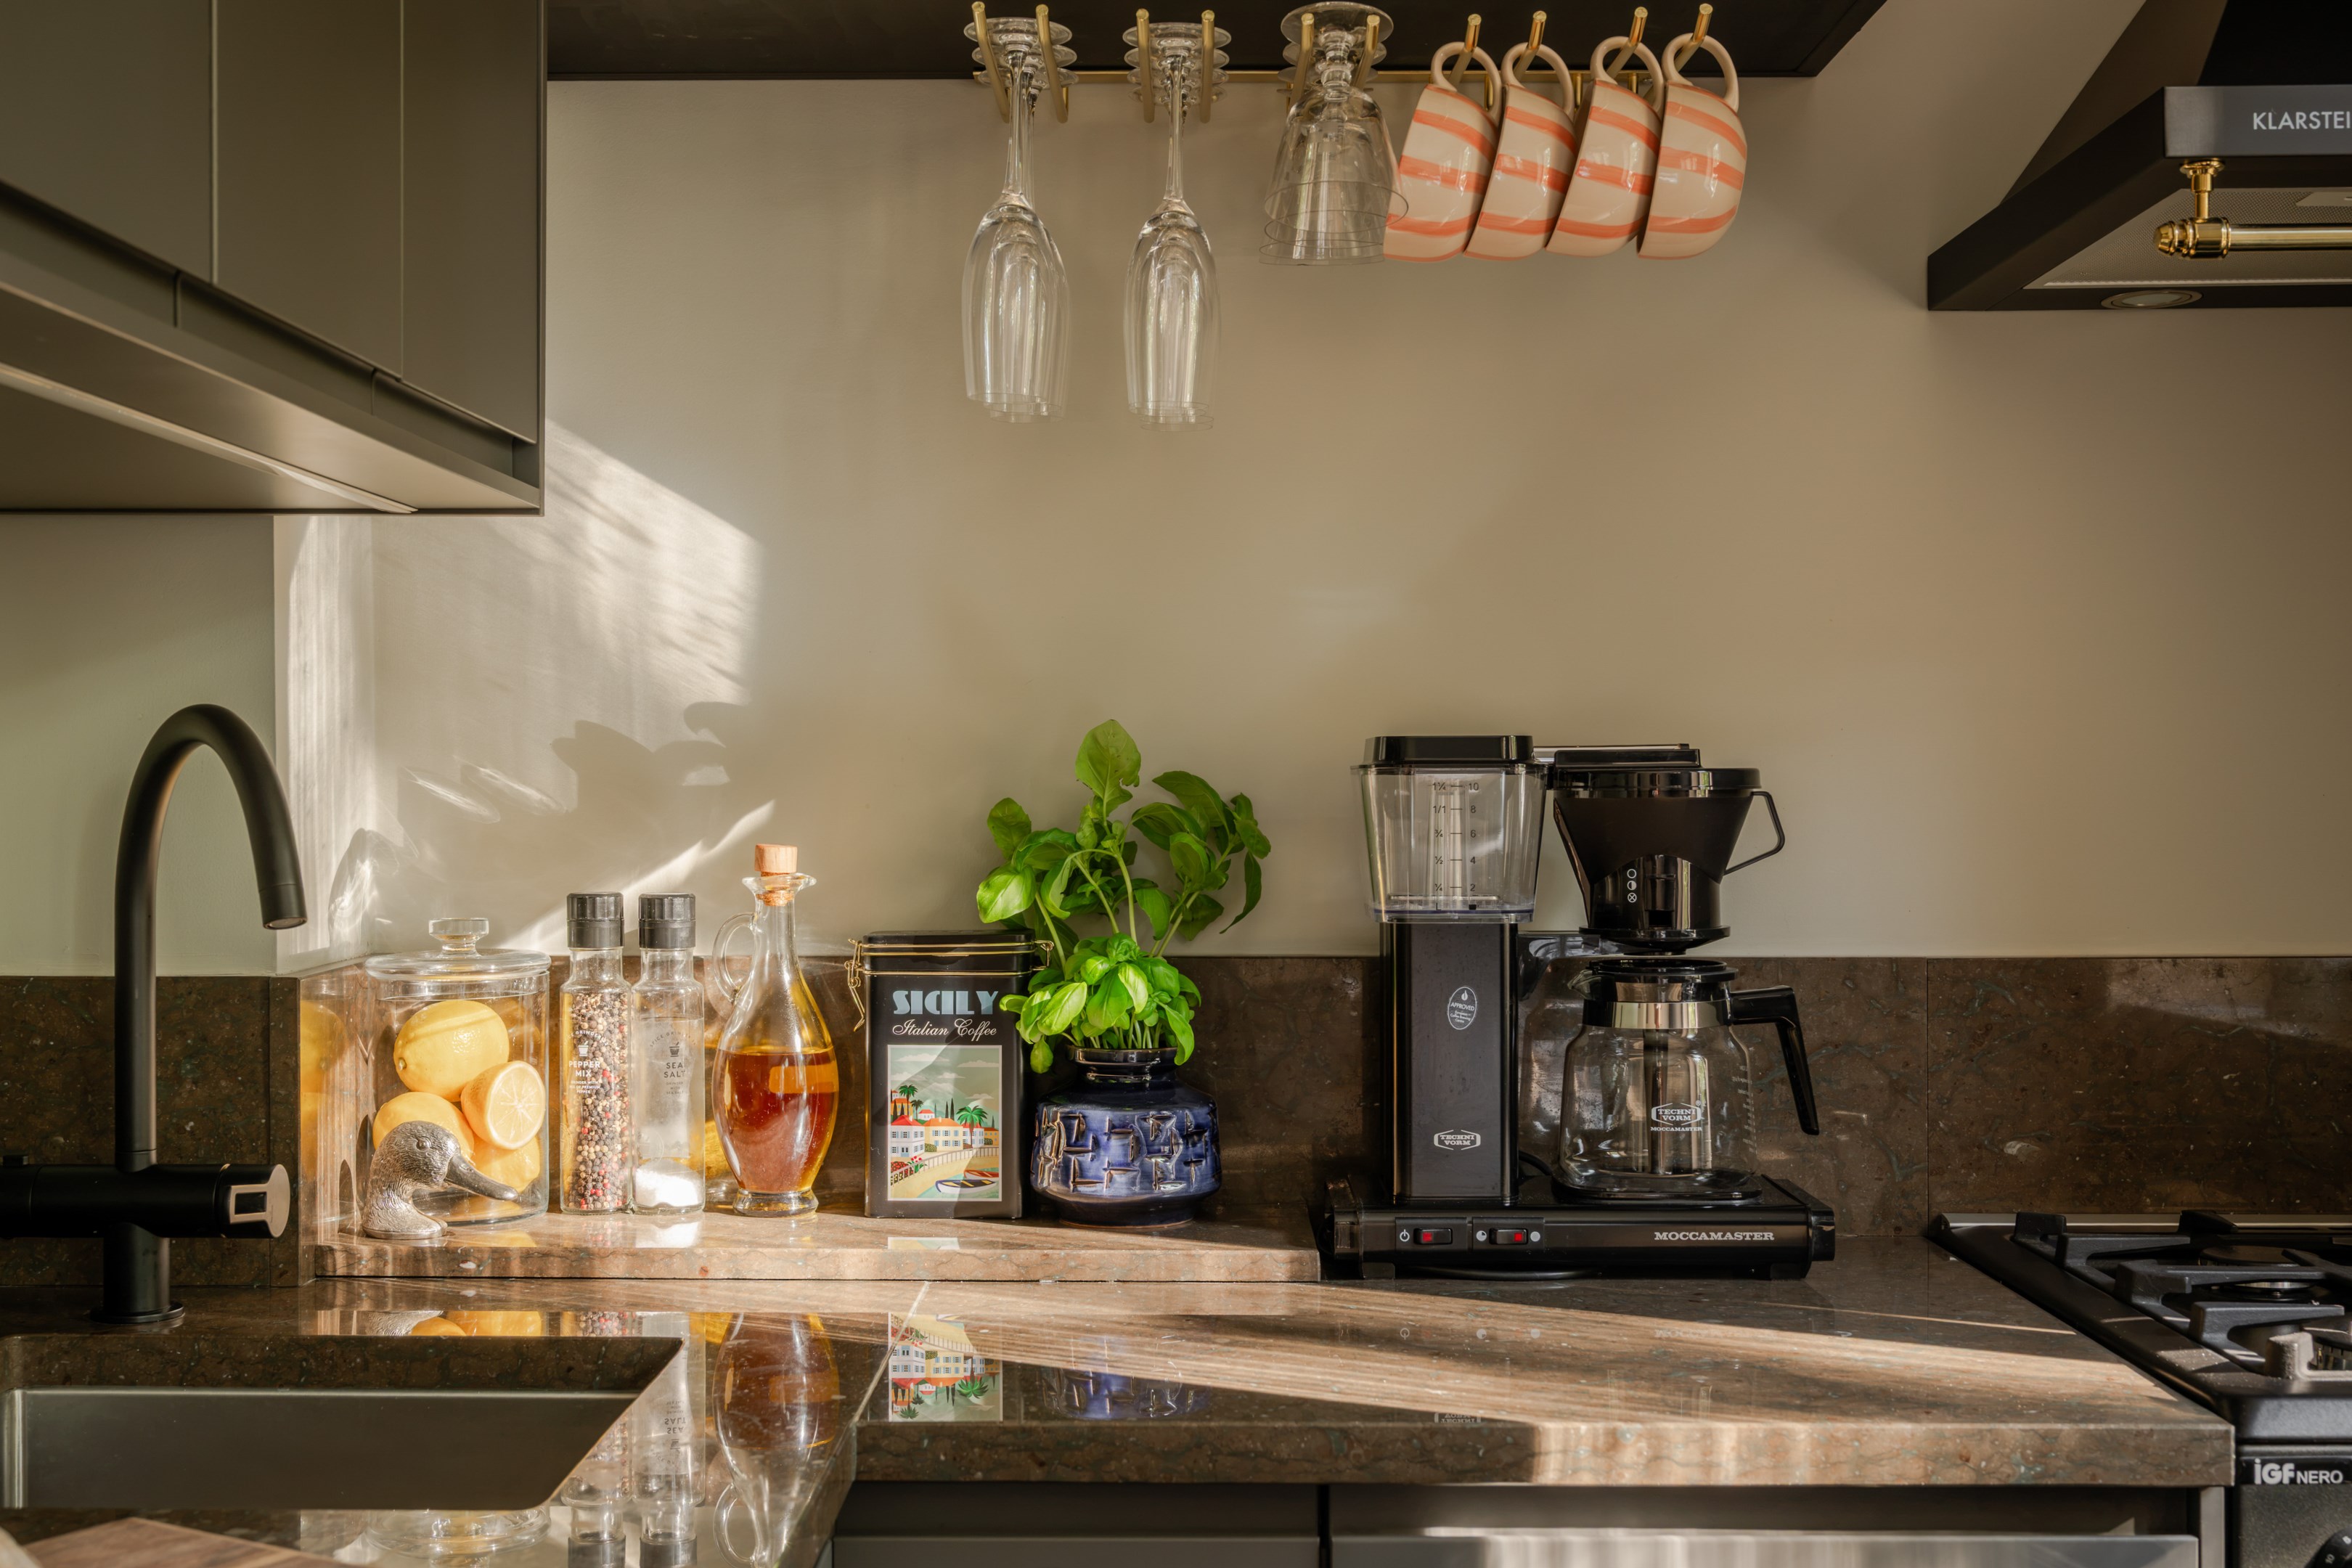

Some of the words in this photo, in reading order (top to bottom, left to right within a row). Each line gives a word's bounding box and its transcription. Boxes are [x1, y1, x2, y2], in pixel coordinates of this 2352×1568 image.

[2253, 111, 2351, 130] KLARSTEI
[1469, 783, 1479, 791] 10
[1470, 805, 1477, 814] 8
[1470, 856, 1476, 865] 4
[892, 990, 999, 1015] SICILY
[1450, 1002, 1474, 1011] APPROVED
[892, 1018, 949, 1036] Italian
[954, 1018, 997, 1042] Coffee
[663, 1070, 686, 1079] SALT
[1654, 1232, 1775, 1241] MOCCAMASTER
[2297, 1470, 2344, 1485] NERO
